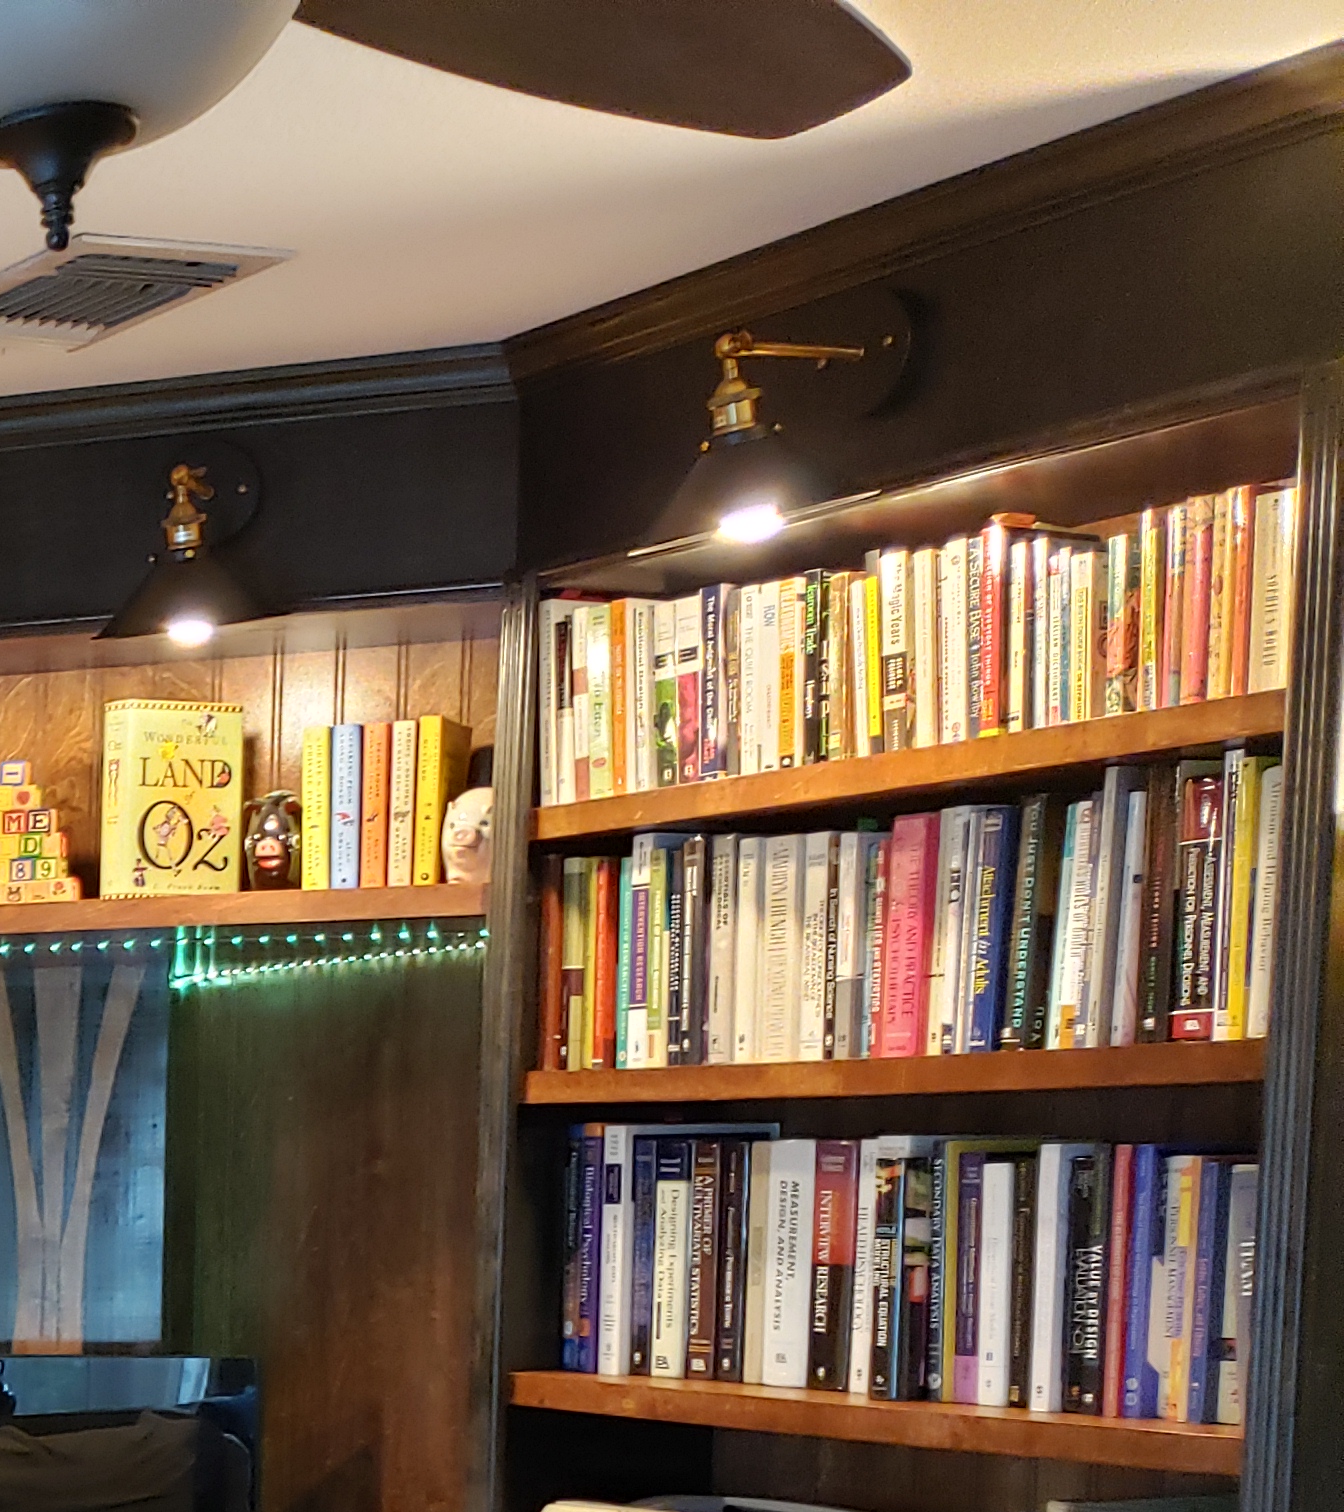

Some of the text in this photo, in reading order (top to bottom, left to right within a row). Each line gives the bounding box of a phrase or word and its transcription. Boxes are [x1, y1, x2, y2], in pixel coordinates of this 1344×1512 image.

[969, 562, 980, 607] SECURE
[806, 628, 818, 655] Trade
[890, 616, 903, 645] Years
[139, 757, 232, 789] LAND
[1265, 838, 1278, 860] and
[1260, 866, 1277, 914] Helping
[974, 865, 996, 994] Attachment Adults
[1258, 918, 1274, 972] Behavior
[668, 1189, 681, 1250] Designing
[658, 1270, 667, 1299] Data
[813, 1190, 833, 1334] INTERVIEW RESEARCH
[1085, 1244, 1104, 1359] VALUE DESIGN
[876, 1302, 889, 1347] EQUATION
